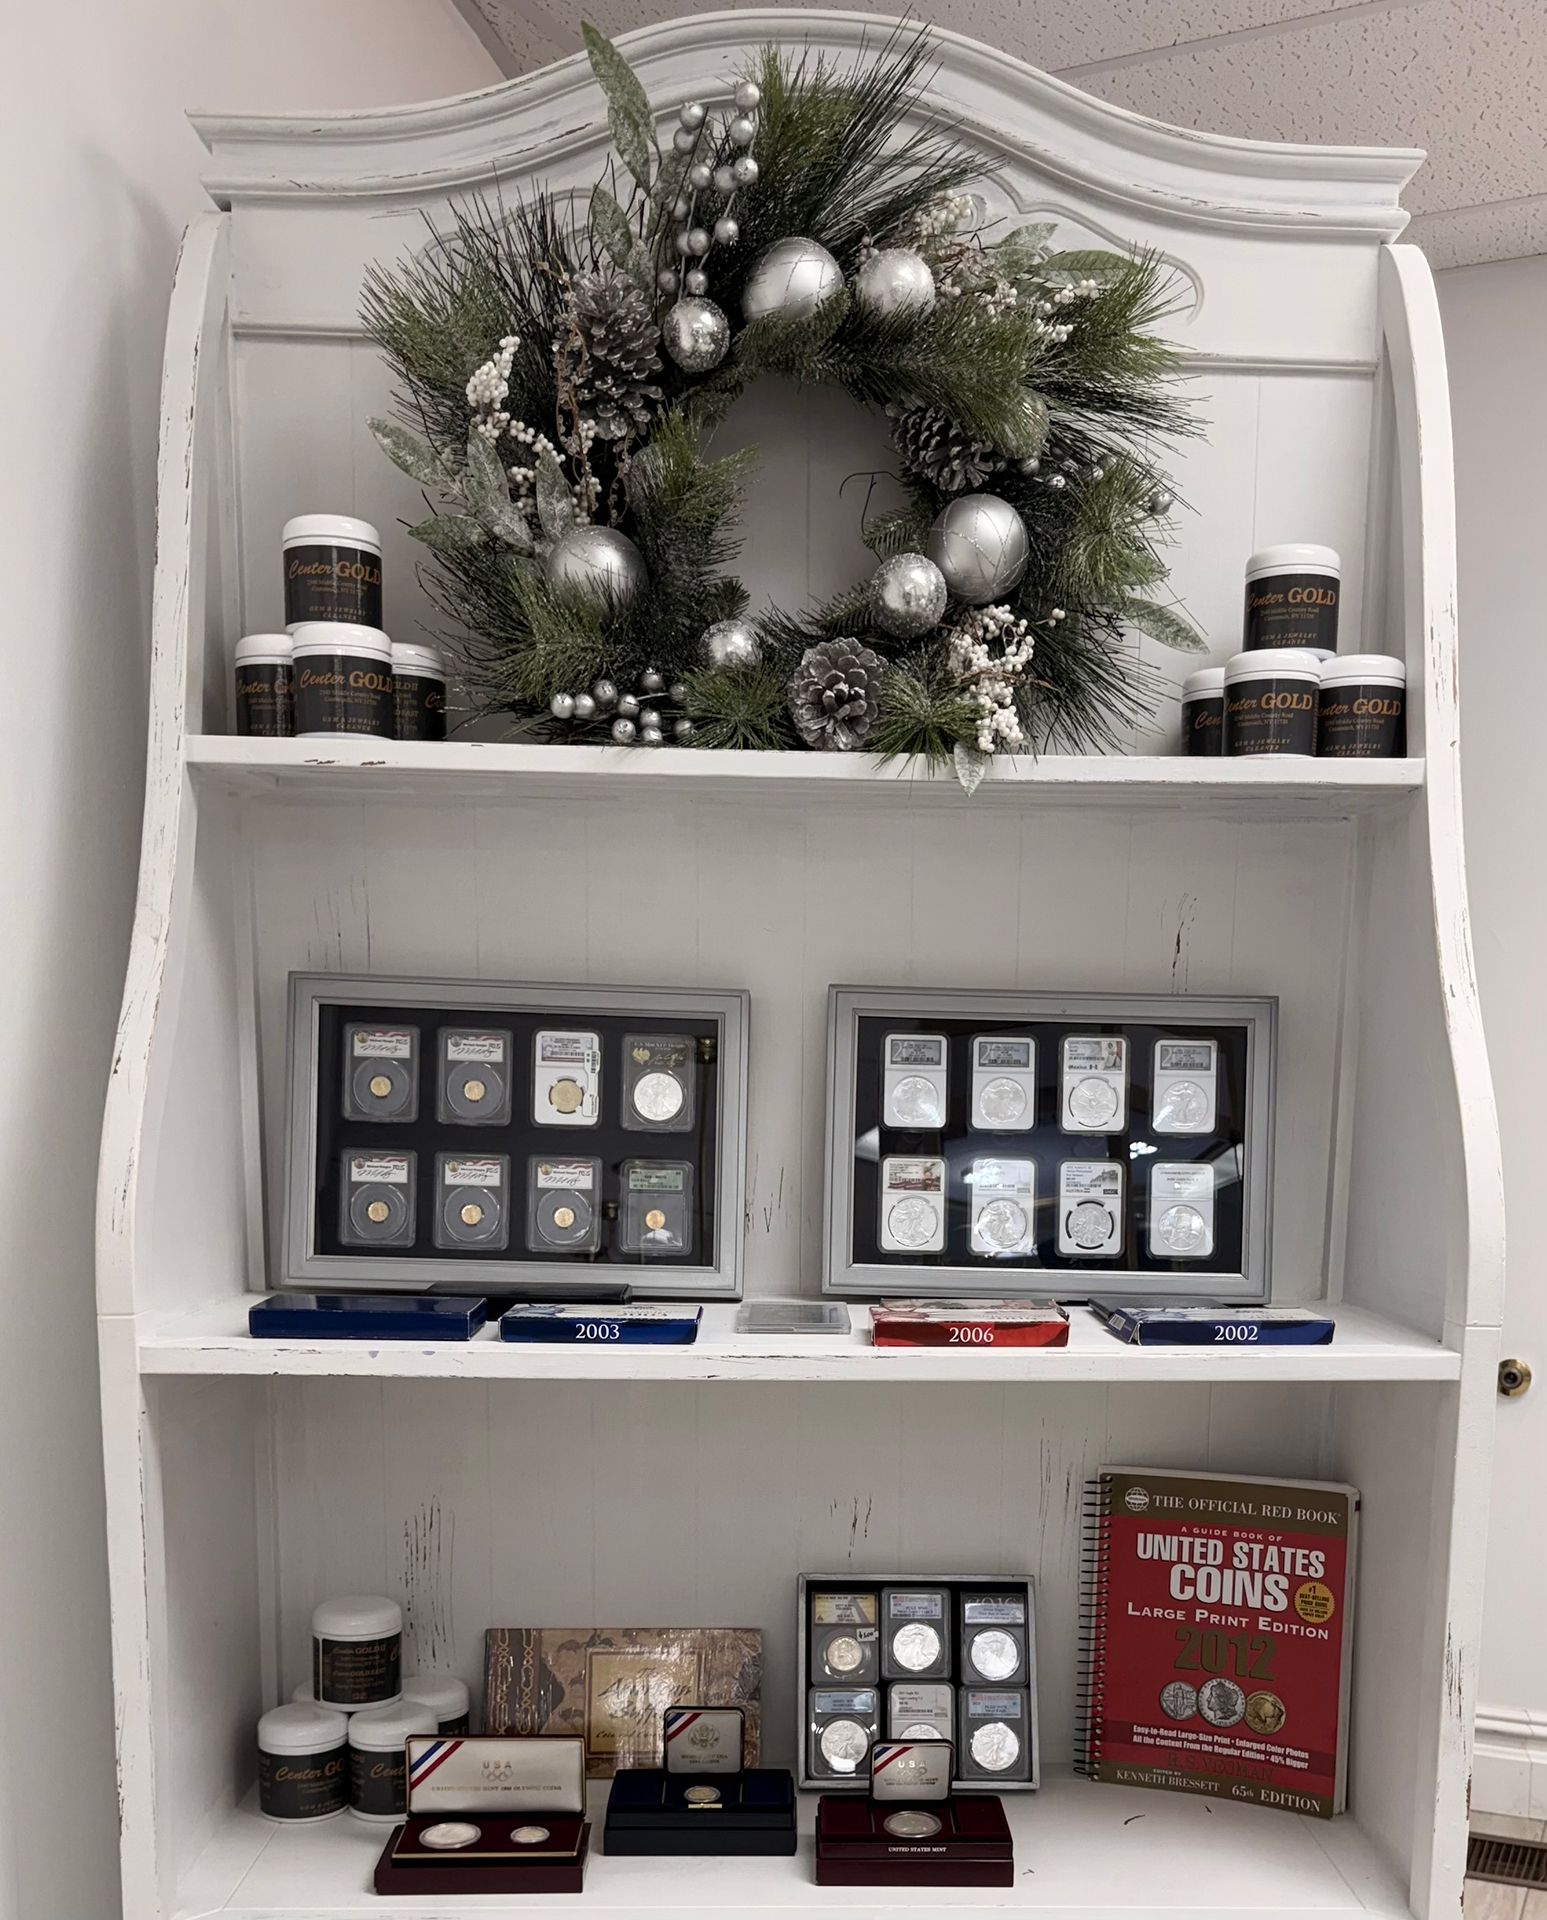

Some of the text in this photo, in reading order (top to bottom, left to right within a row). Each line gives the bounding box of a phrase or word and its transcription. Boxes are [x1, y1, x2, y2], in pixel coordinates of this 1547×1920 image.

[289, 560, 381, 585] Center GOLD
[1248, 587, 1336, 611] Center GOLD
[300, 669, 346, 689] Center
[349, 671, 393, 693] GOLD
[1260, 692, 1312, 711] GOLD
[1352, 698, 1402, 717] GOLD
[575, 1323, 620, 1339] 2003
[949, 1327, 994, 1343] 2006
[1214, 1325, 1258, 1341] 2002
[1152, 1495, 1338, 1525] THE OFFICIAL RED BOOK
[1192, 1527, 1228, 1537] GUIDE
[1233, 1531, 1264, 1540] BOOK
[1268, 1534, 1283, 1542] OF
[1136, 1532, 1326, 1579] UNITED STATES
[1169, 1563, 1290, 1613] COINS
[1173, 1624, 1277, 1682] 2012
[1132, 1734, 1309, 1769] All the Content From the Regular Edition 45% Bigger
[1133, 1724, 1309, 1759] Easy-to-Read Large-Size Print Enlarged Color Photos
[275, 1758, 345, 1781] Center GO
[370, 1763, 406, 1778] Cent
[1116, 1769, 1166, 1785] KENNETH
[1168, 1776, 1220, 1792] BRESSETT
[1260, 1789, 1321, 1813] EDITION
